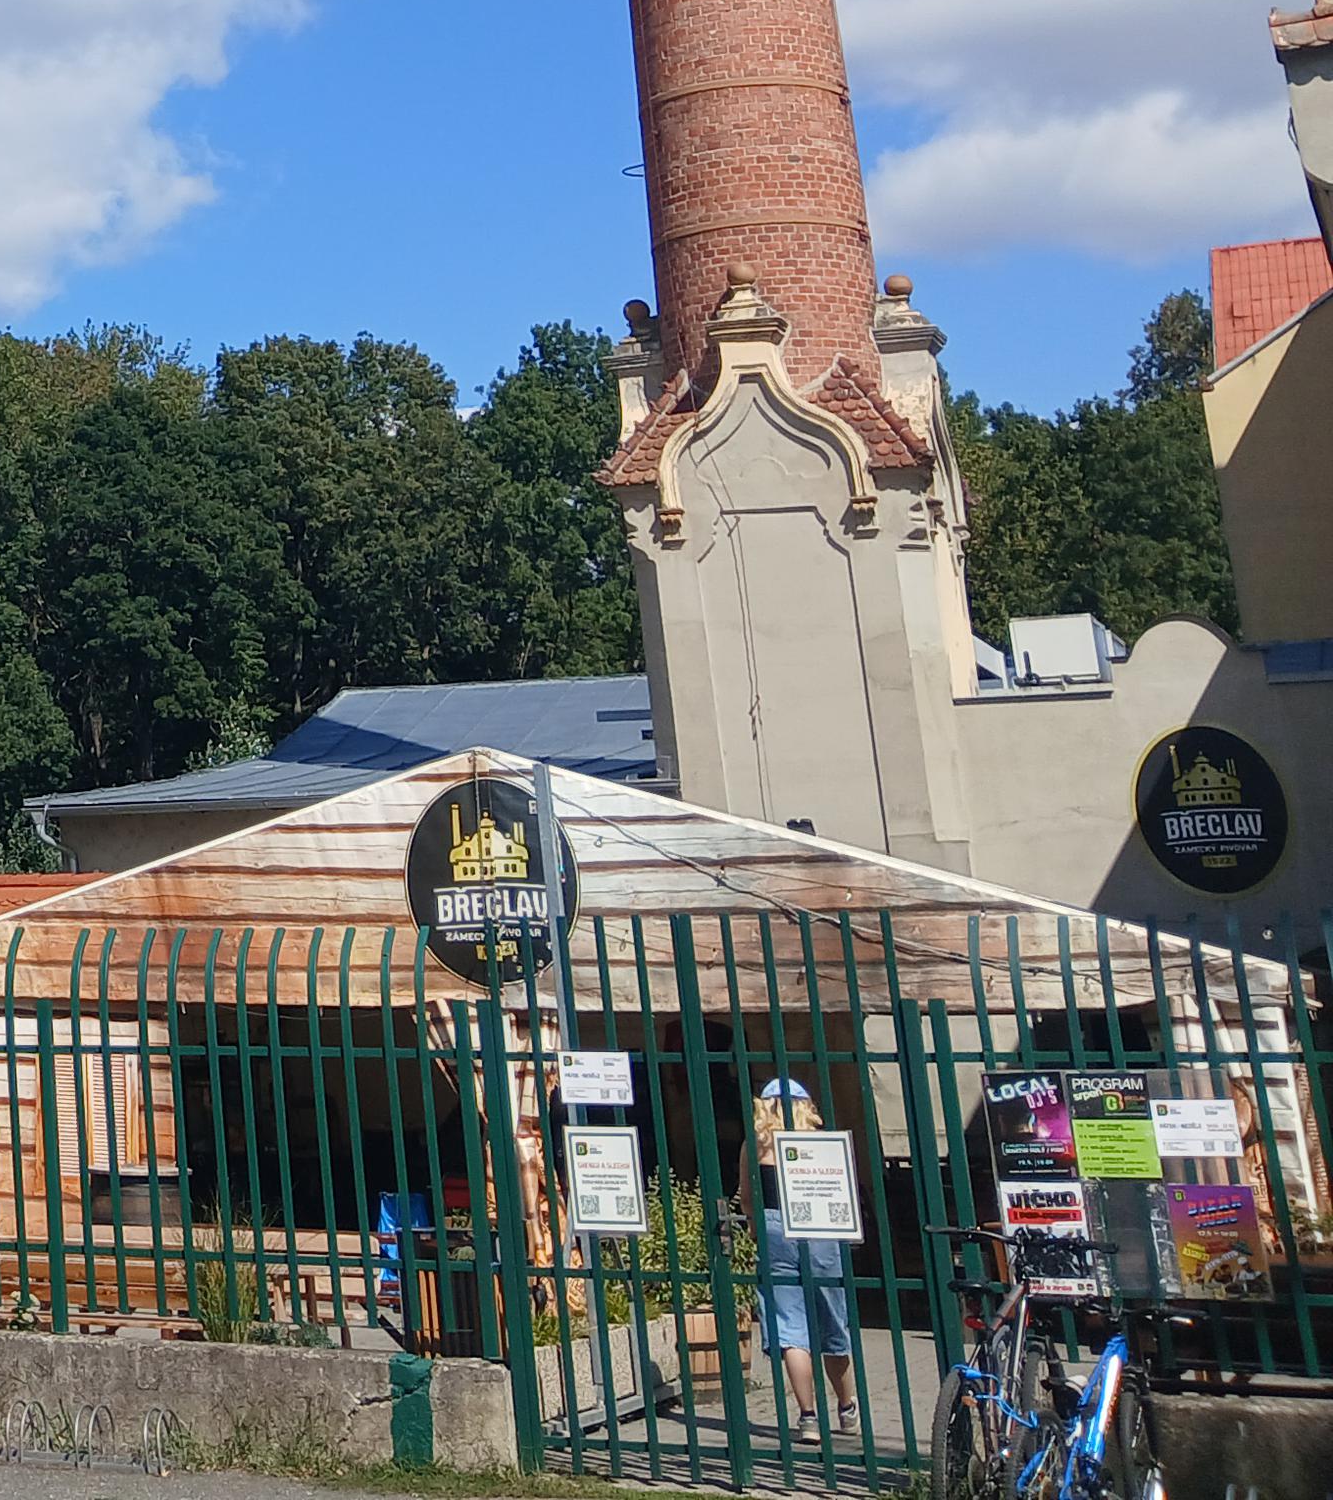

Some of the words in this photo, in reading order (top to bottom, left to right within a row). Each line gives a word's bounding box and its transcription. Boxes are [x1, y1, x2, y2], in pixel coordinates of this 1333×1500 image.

[987, 1076, 1058, 1103] LOCAL
[1071, 1077, 1144, 1091] PROGRAM
[1072, 1089, 1103, 1102] srpen
